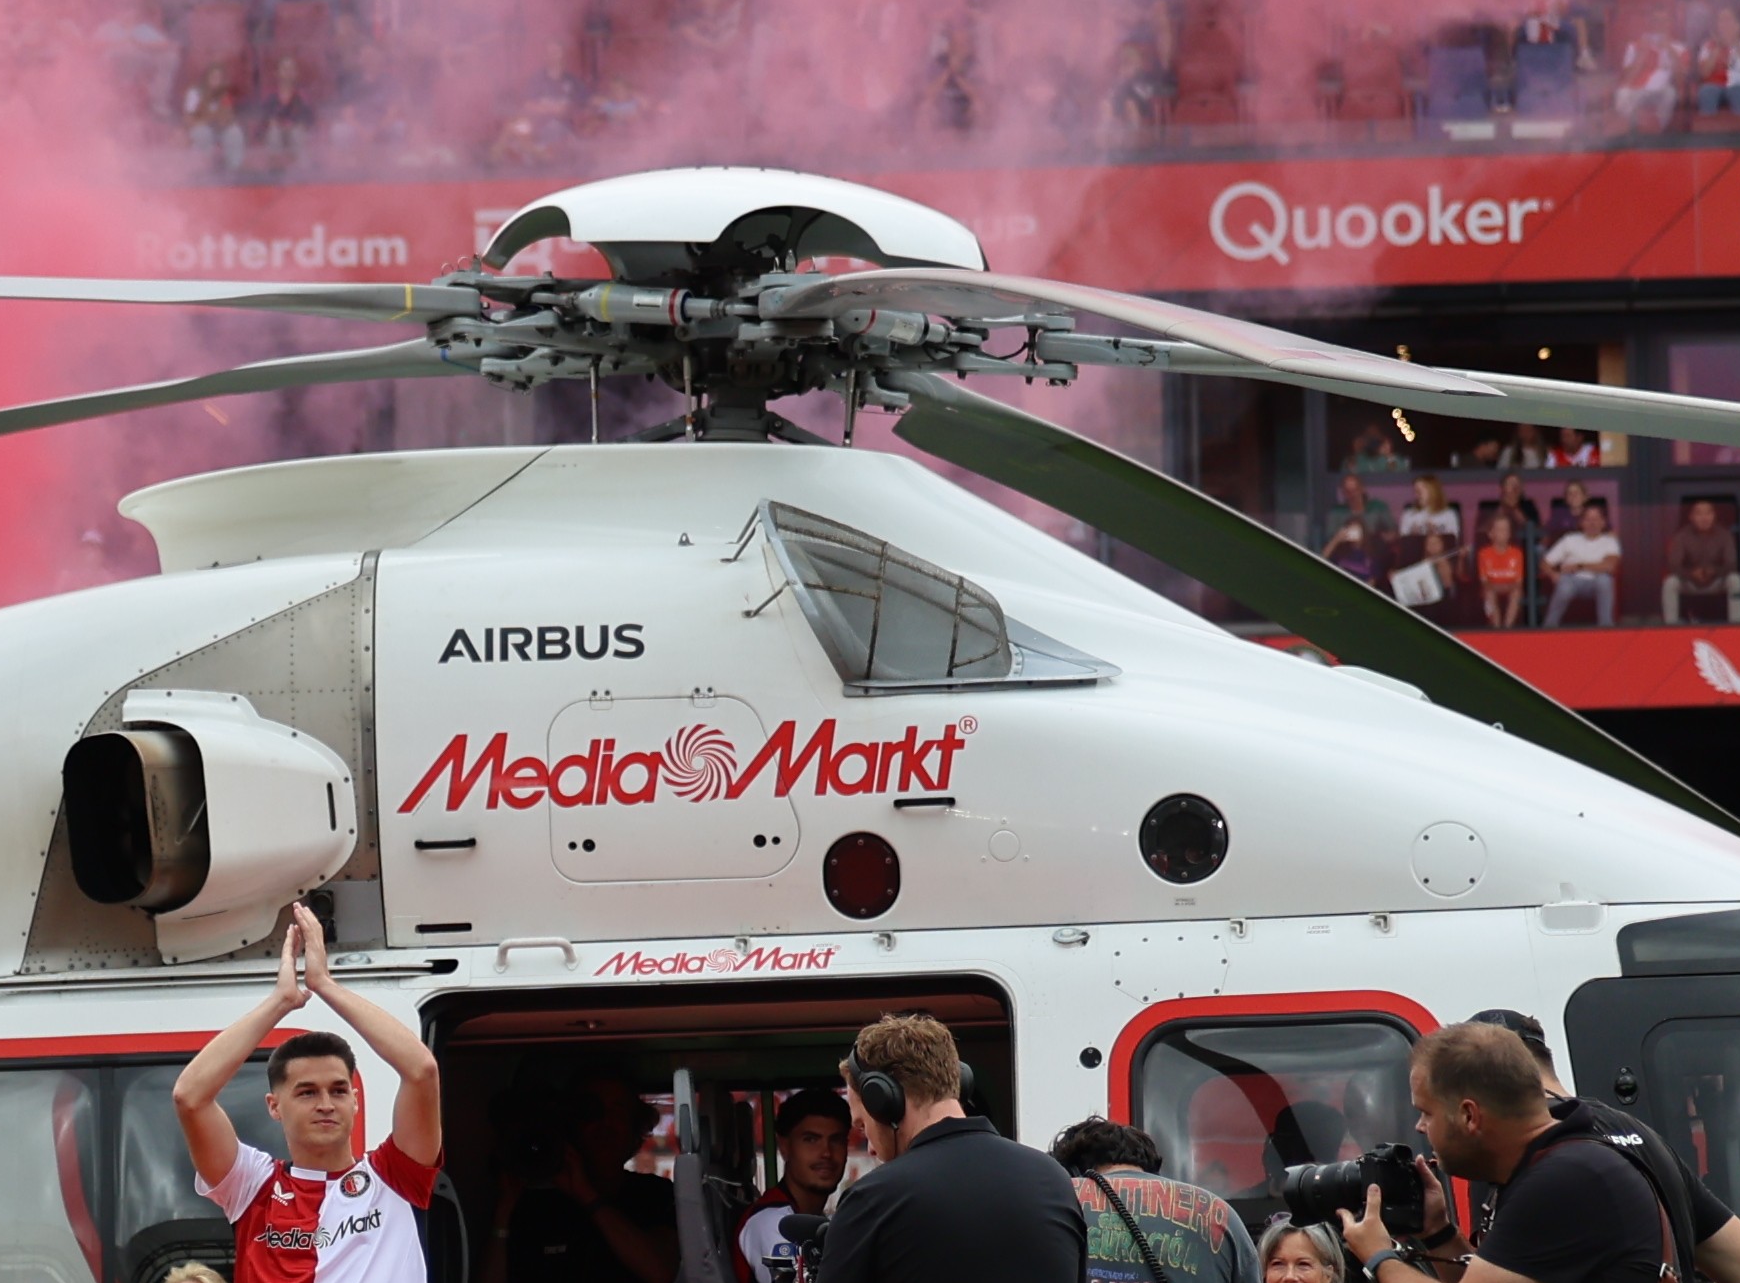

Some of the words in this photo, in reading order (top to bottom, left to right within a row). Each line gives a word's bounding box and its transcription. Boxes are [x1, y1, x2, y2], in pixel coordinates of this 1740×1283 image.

[136, 223, 410, 271] Rotterdam
[1208, 180, 1541, 267] Quooker
[438, 623, 646, 664] AIRBUS
[396, 731, 660, 814] Media
[723, 718, 966, 799] Markt
[593, 951, 707, 976] Media
[732, 946, 836, 972] Markt
[1071, 1177, 1230, 1254] ANTINERO
